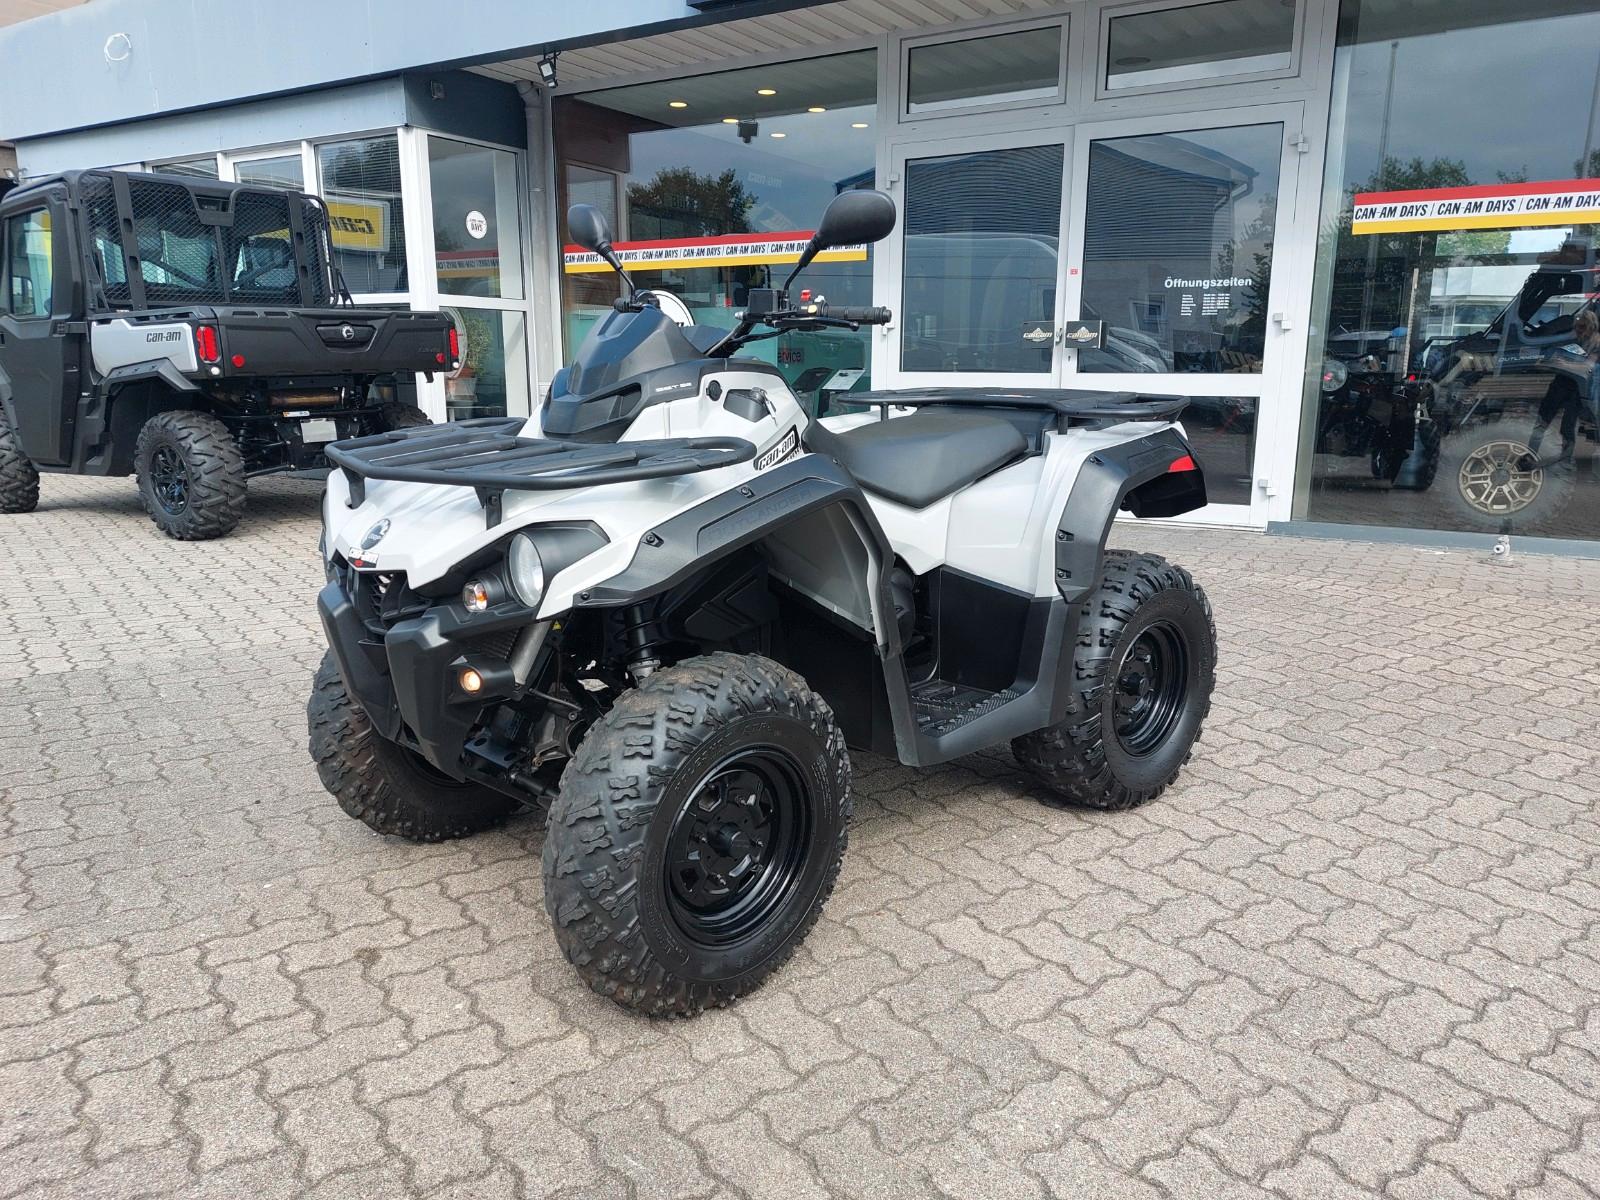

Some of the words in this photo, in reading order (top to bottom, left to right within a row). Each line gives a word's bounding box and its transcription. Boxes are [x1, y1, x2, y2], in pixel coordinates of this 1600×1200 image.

[1355, 206, 1398, 220] CAN-AM
[1399, 204, 1428, 217] DAYS
[1437, 201, 1483, 215] CAN-AM
[1485, 199, 1516, 212] DAYS
[1526, 196, 1573, 210] CAN-AM
[565, 253, 584, 263] CAN-AM
[586, 253, 599, 262] DAYS
[625, 251, 637, 260] DAYS
[642, 250, 663, 259] CAN-AM
[664, 249, 678, 258] DAYS
[683, 248, 705, 257] CAN-AM
[706, 247, 721, 256] DAYS
[726, 245, 749, 254] CAN-AM
[750, 244, 766, 253] DAYS
[771, 243, 794, 252] CAN-AM
[1164, 276, 1253, 290] Öffnungszeiten
[758, 433, 795, 470] can-am
